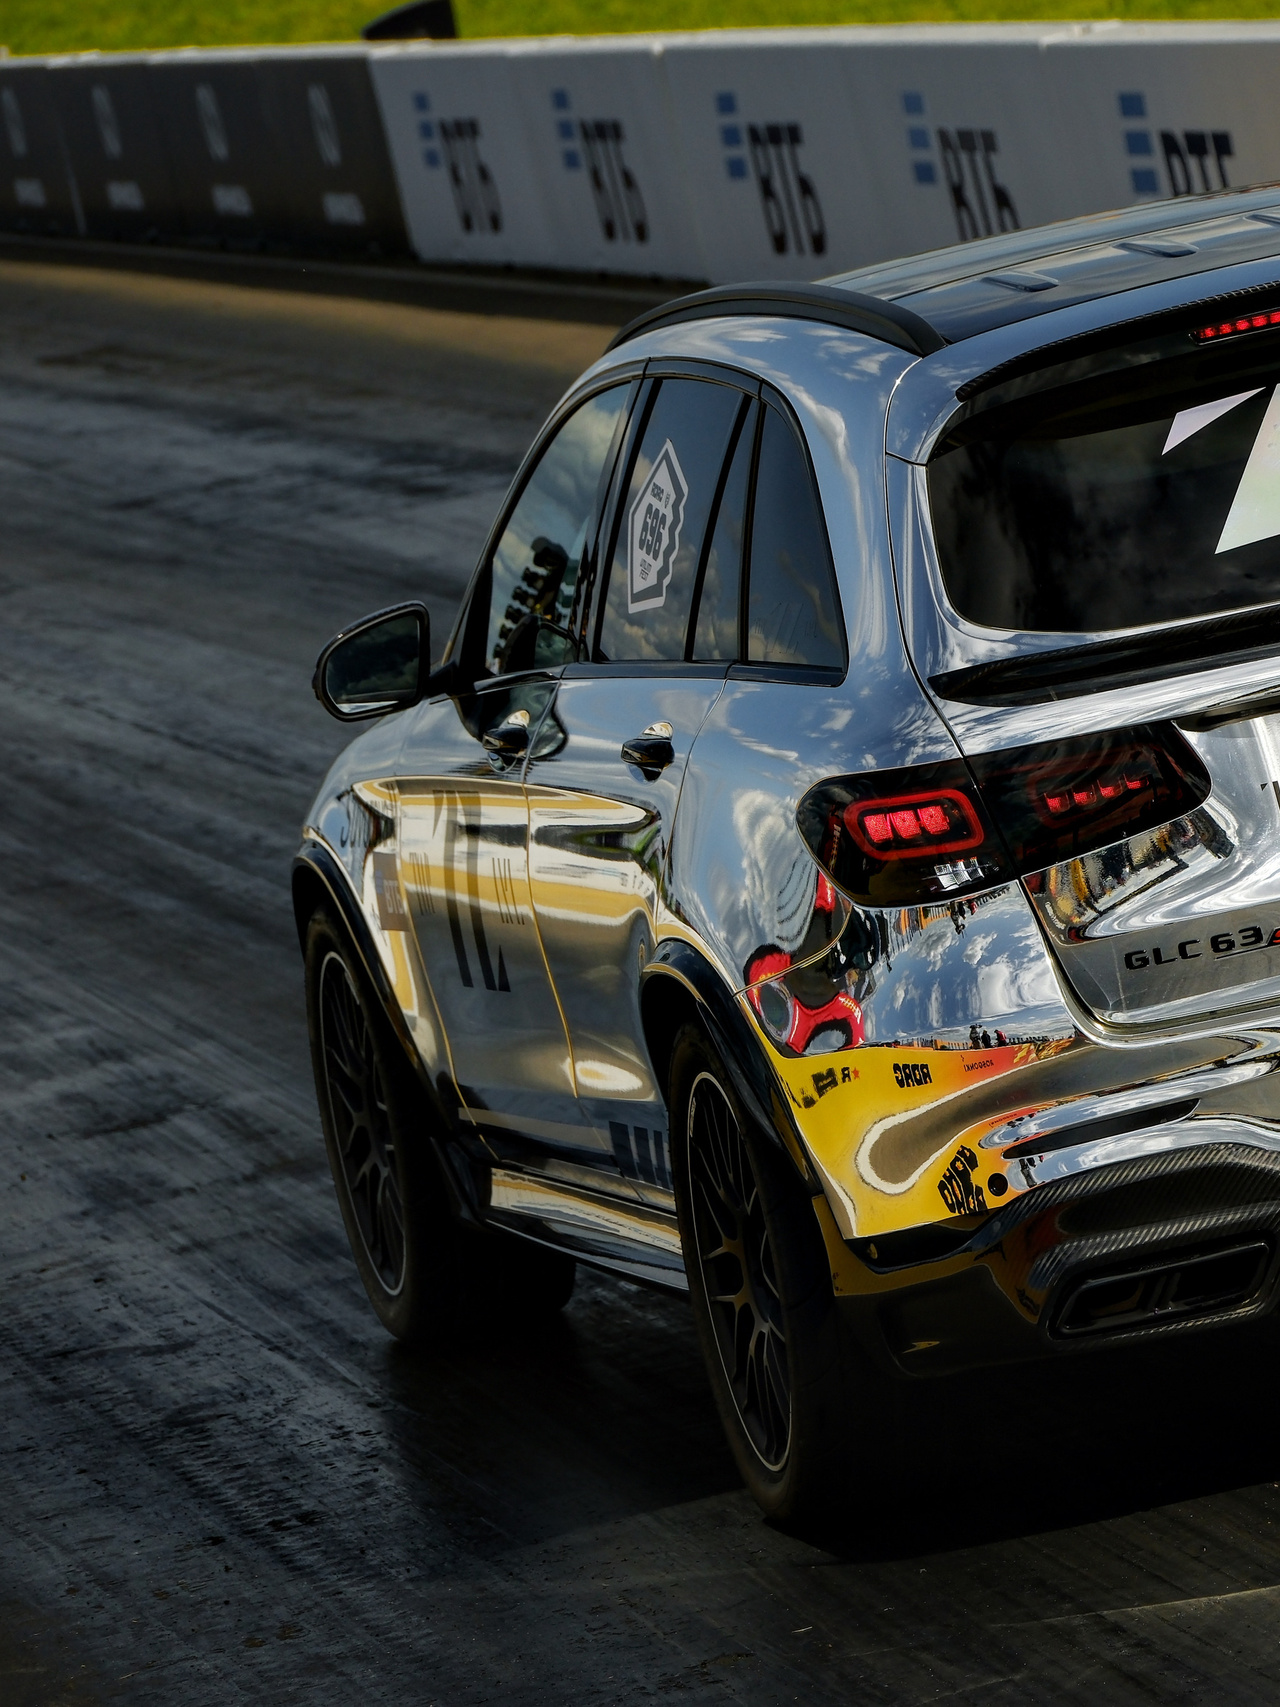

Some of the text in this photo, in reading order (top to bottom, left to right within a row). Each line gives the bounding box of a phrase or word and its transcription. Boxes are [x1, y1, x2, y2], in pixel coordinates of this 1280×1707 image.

[747, 123, 827, 256] ВТБ
[638, 502, 667, 561] 696
[1123, 938, 1203, 971] GLC
